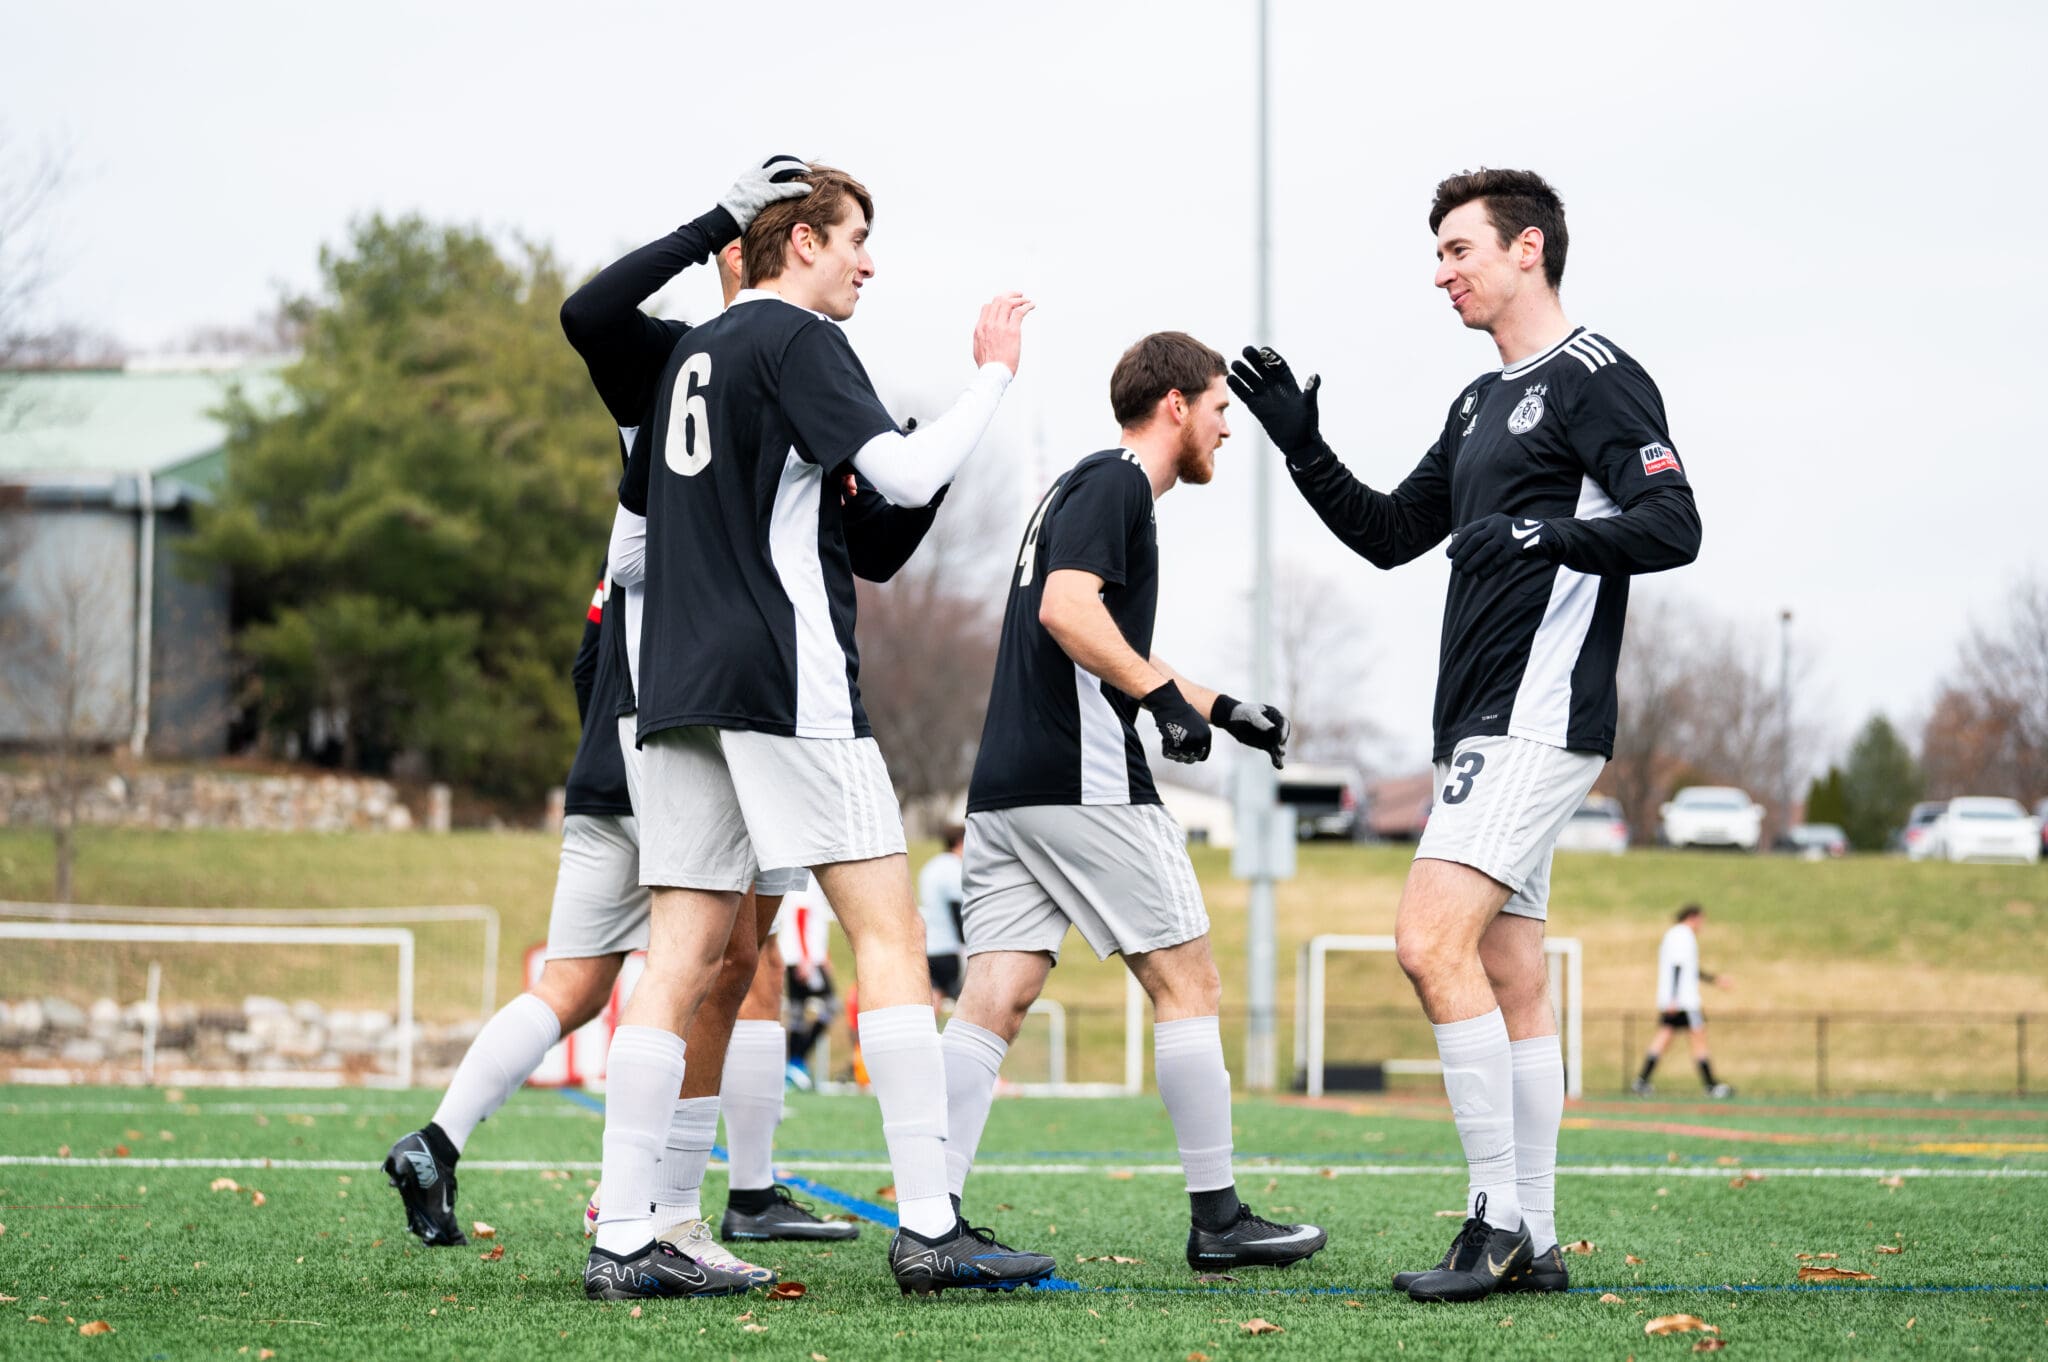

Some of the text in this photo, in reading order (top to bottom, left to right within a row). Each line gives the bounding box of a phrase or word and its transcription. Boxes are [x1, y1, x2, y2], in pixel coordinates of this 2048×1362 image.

[665, 352, 712, 477] 6
[1016, 486, 1060, 587] 4
[1442, 751, 1486, 805] 3
